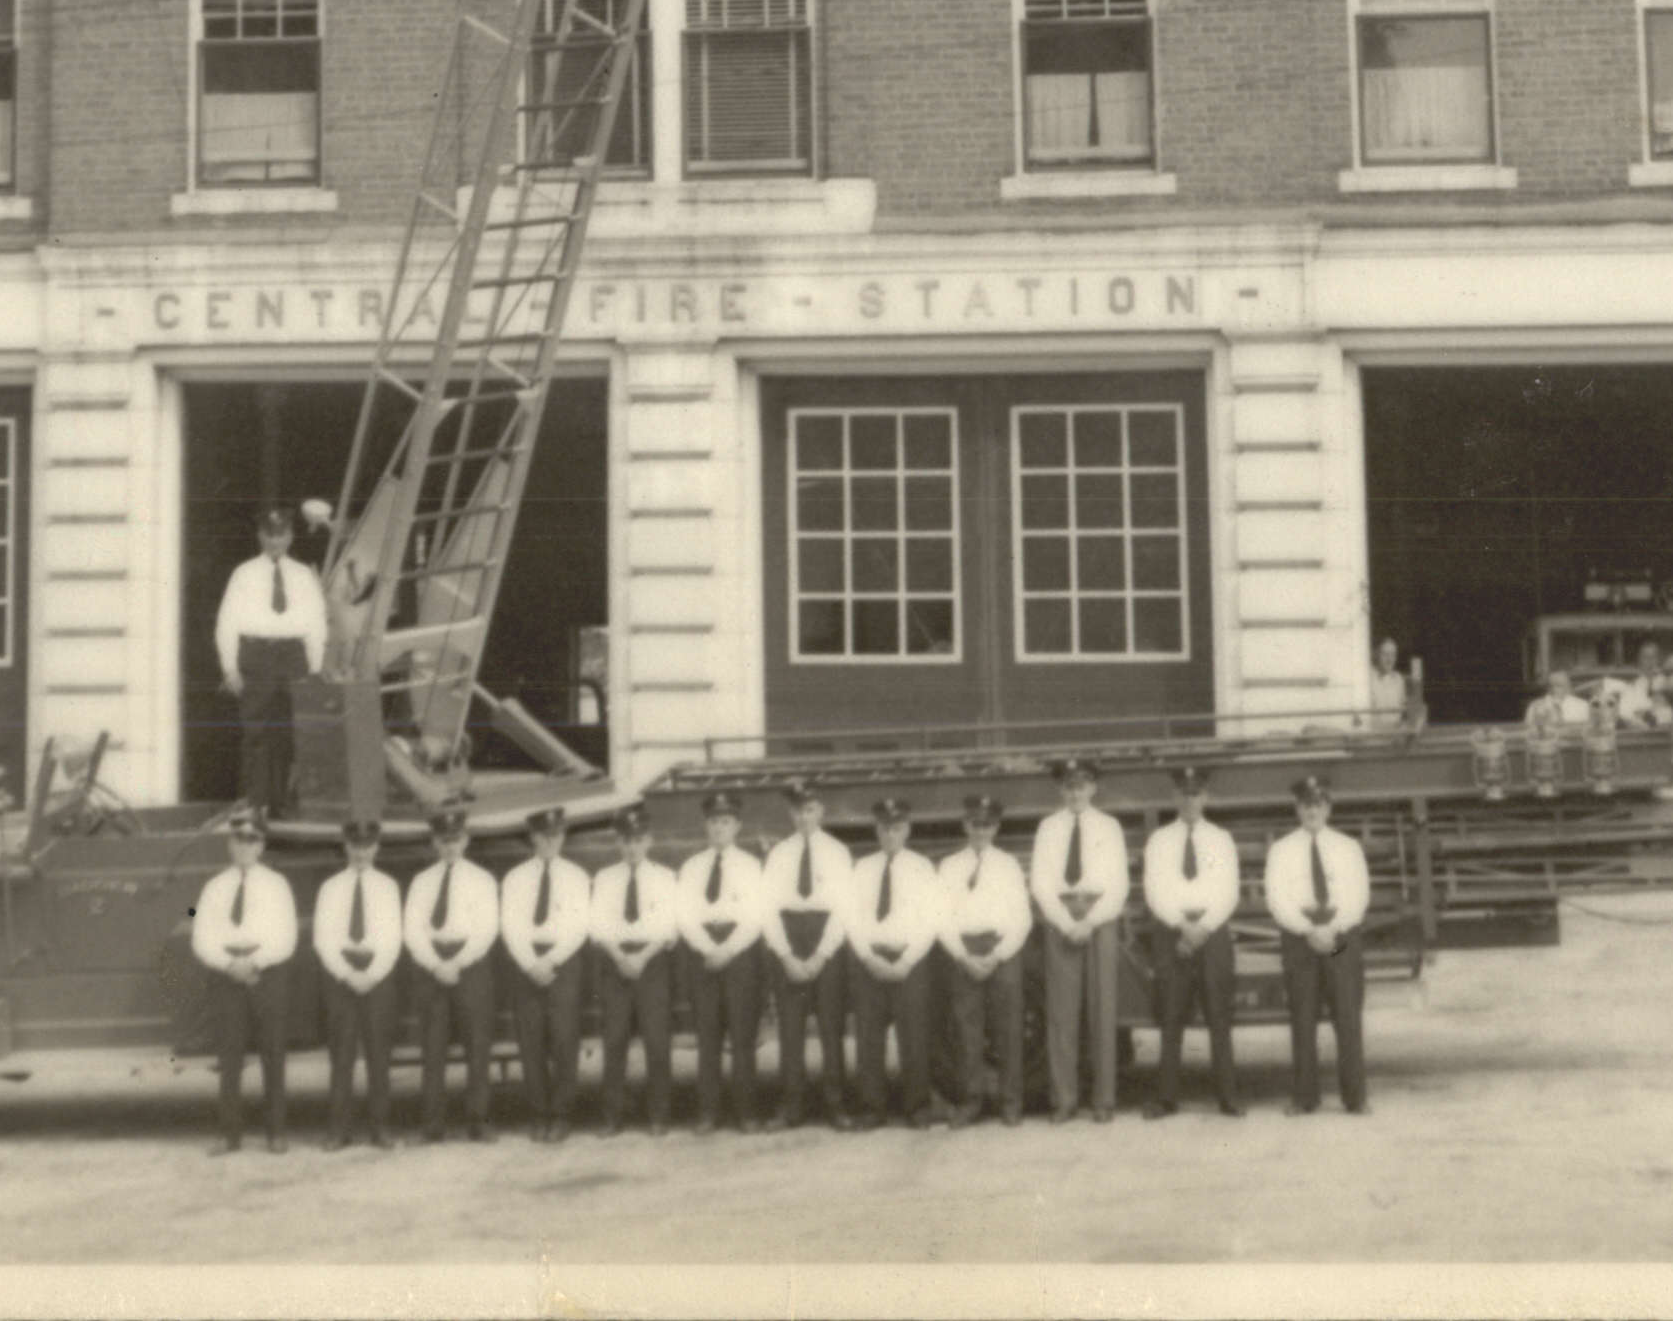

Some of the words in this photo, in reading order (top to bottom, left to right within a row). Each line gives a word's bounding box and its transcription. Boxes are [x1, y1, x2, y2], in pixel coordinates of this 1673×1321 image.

[153, 288, 490, 331] CENTRAL
[588, 283, 748, 325] FIRE
[858, 275, 1195, 321] STATION
